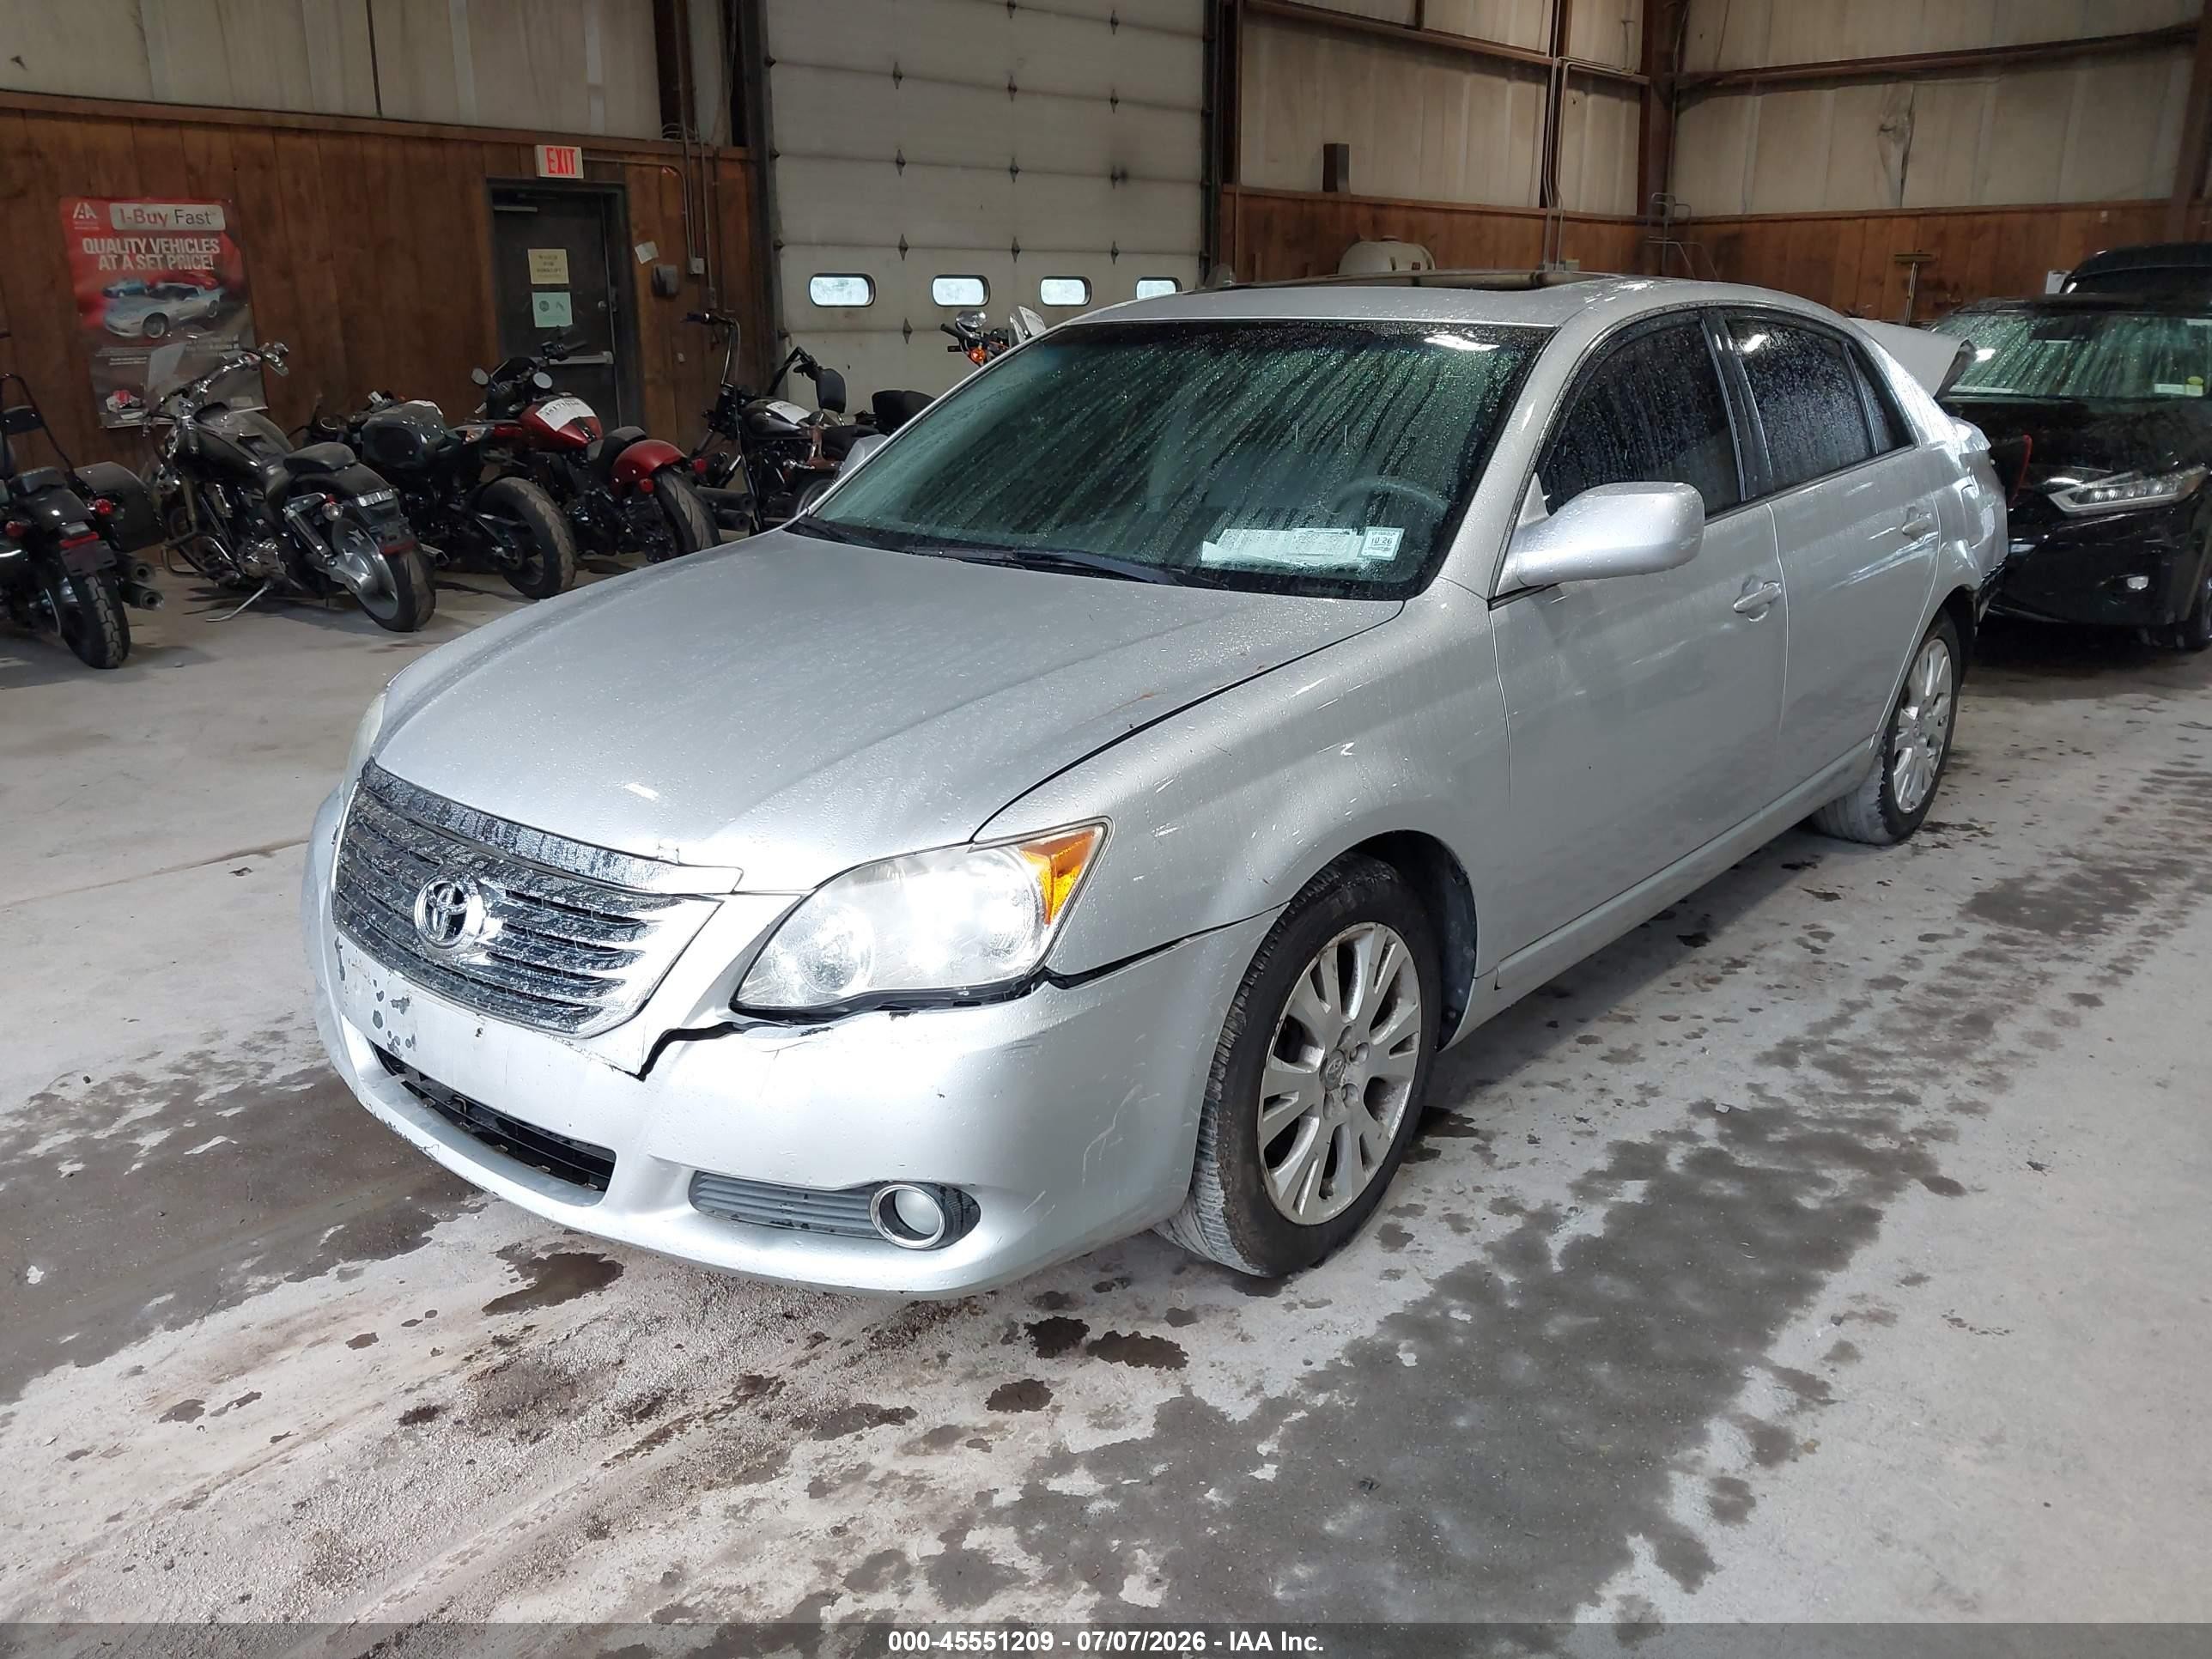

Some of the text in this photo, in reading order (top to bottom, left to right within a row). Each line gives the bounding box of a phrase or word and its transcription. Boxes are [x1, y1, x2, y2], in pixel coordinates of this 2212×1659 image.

[546, 147, 575, 175] EXIT
[119, 209, 168, 228] I-Buy
[82, 238, 221, 255] QUALITY VEHICLES
[99, 254, 215, 270] AT A SET PRICE!
